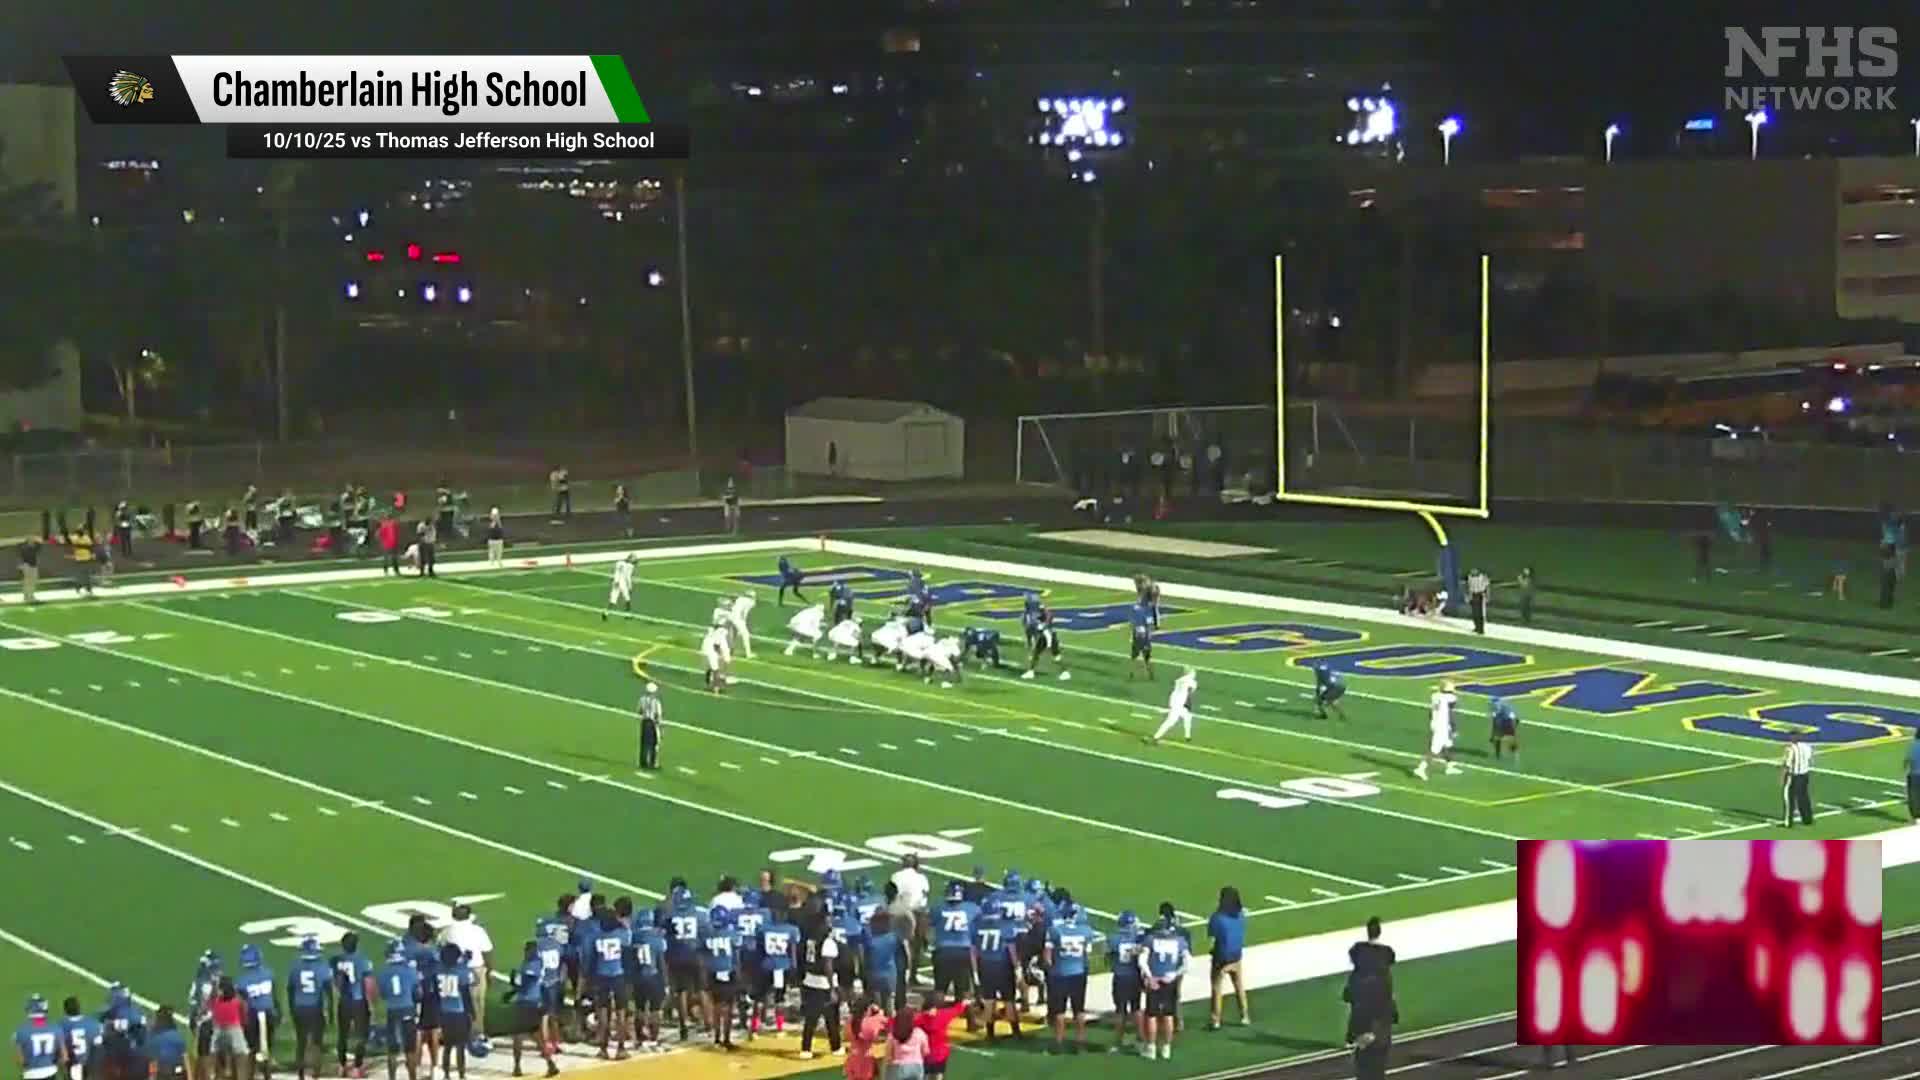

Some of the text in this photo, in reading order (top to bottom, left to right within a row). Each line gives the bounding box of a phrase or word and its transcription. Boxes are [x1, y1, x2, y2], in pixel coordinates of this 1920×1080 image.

[1216, 777, 1382, 808] 10
[768, 834, 974, 873] 20
[672, 916, 697, 940] 33
[942, 910, 968, 931] 72
[596, 937, 622, 960] 42
[706, 936, 732, 957] 44
[765, 932, 791, 955] 65
[978, 930, 1001, 951] 77
[300, 970, 315, 993] 5
[391, 975, 401, 996] 1
[71, 1028, 87, 1055] 5
